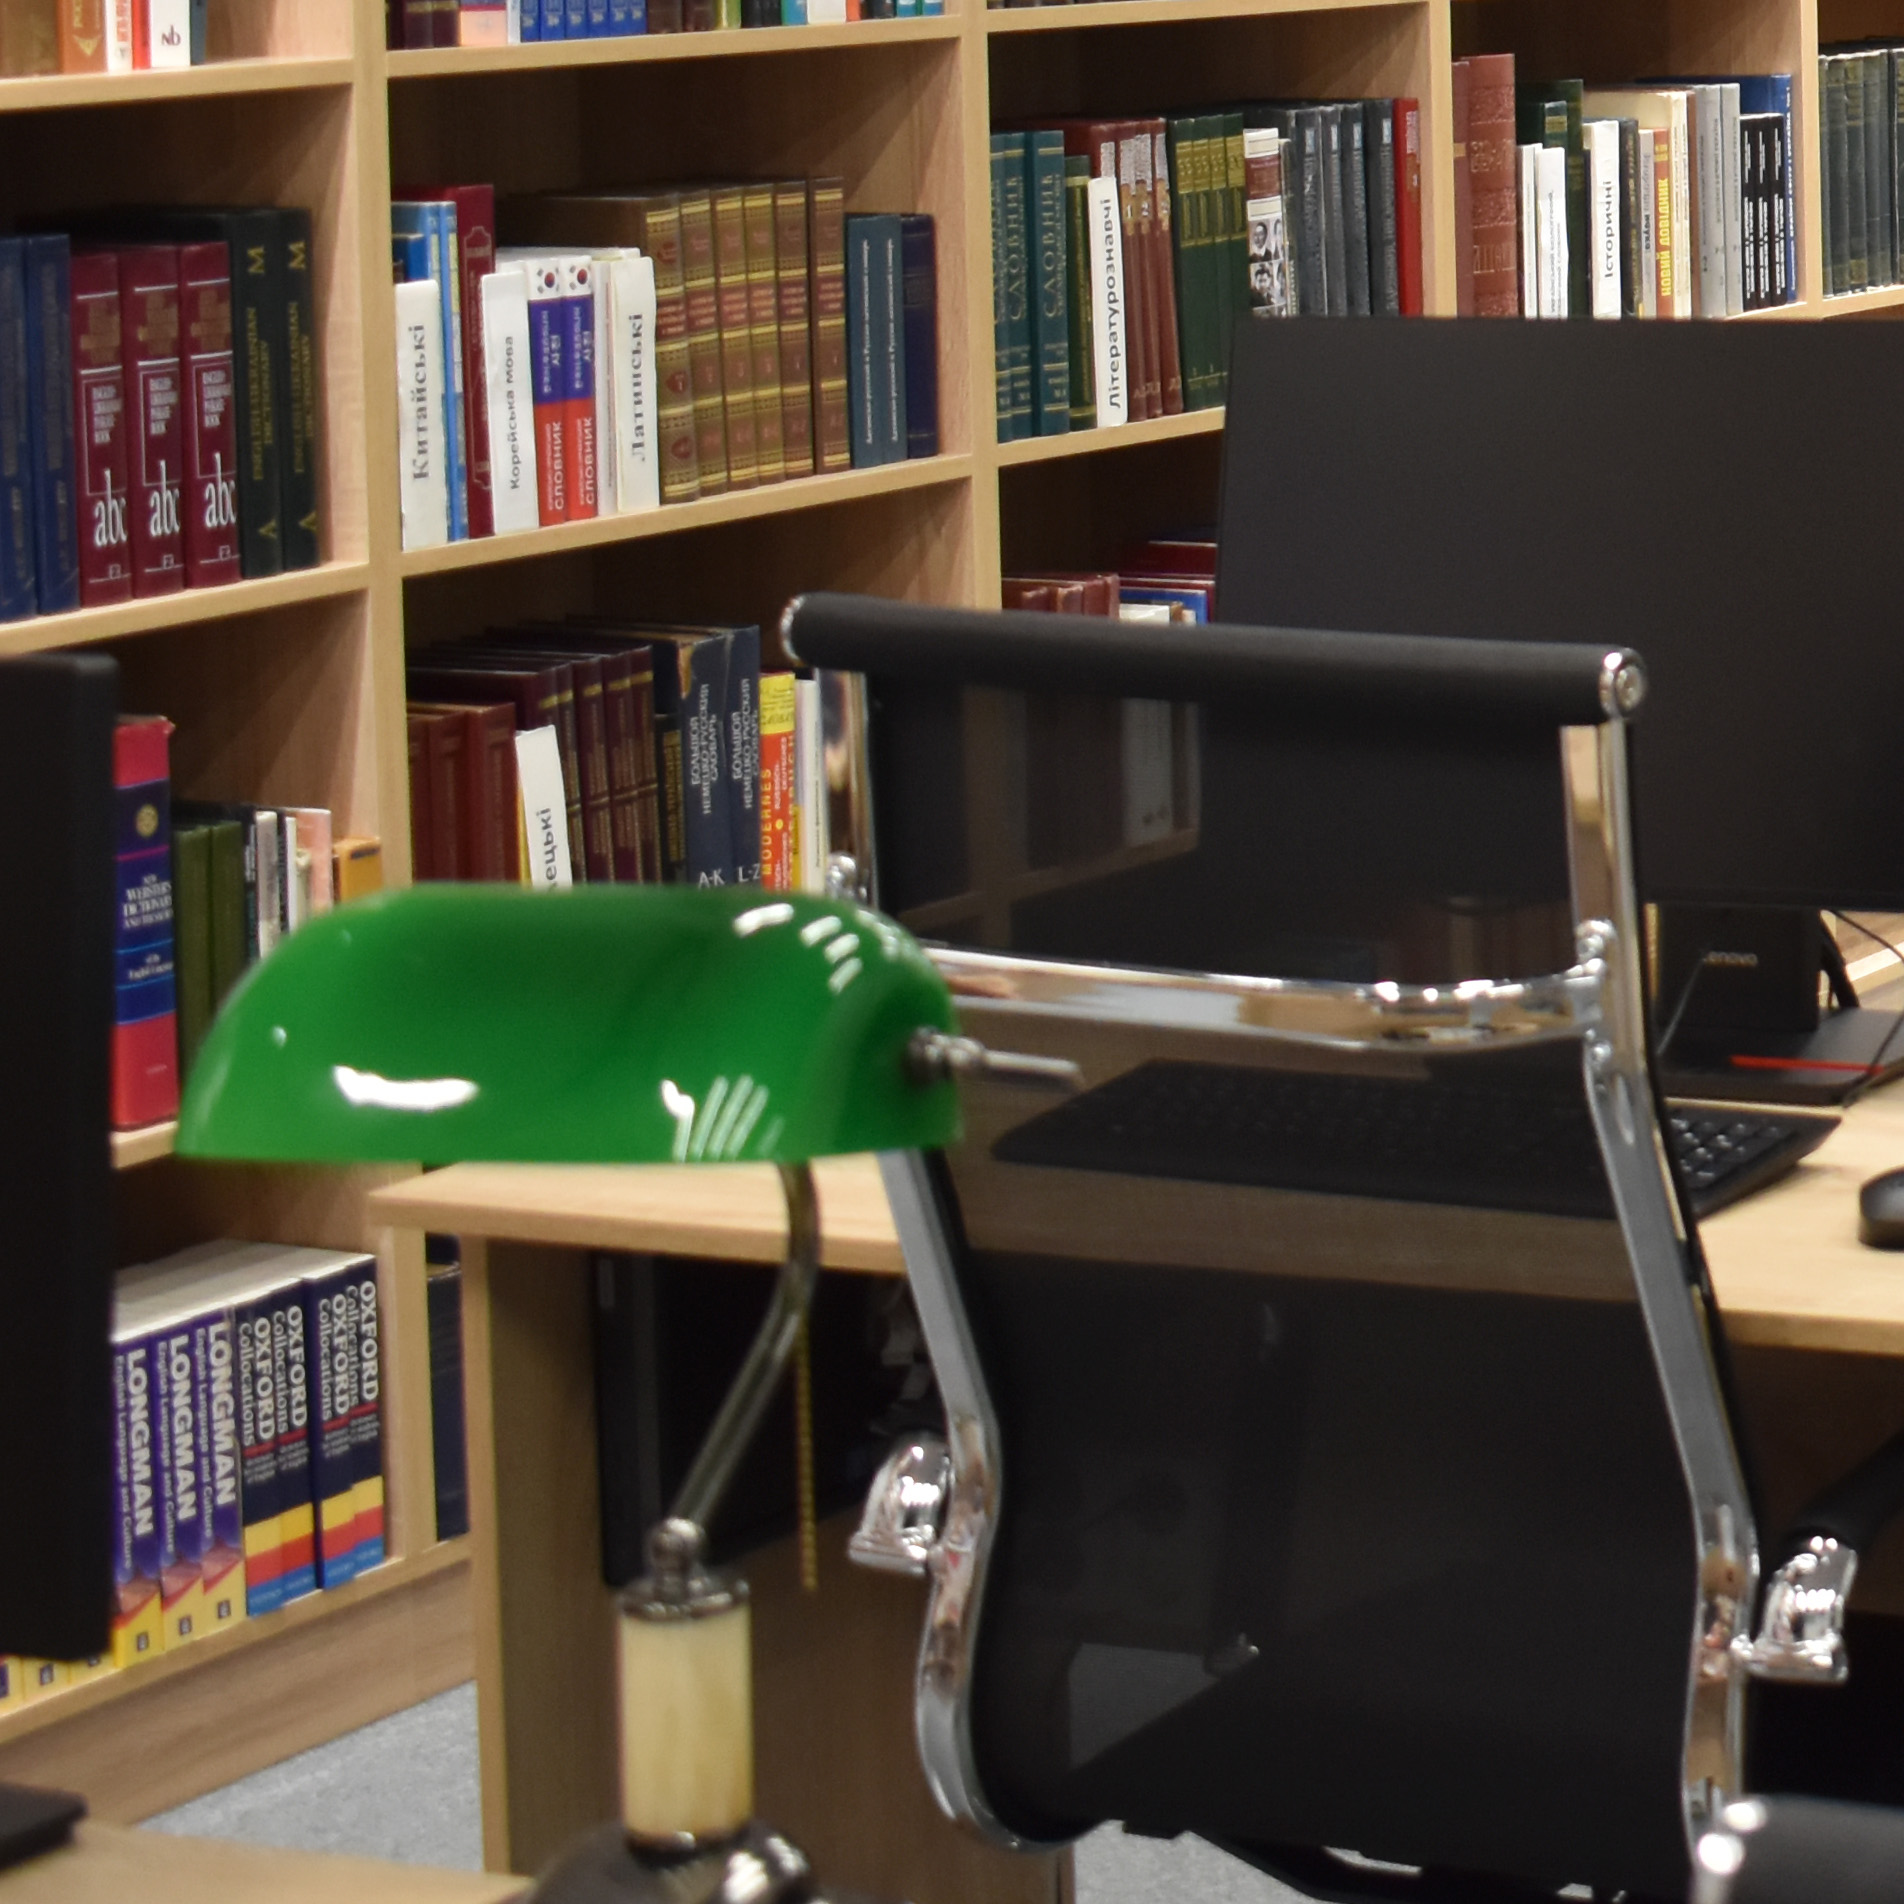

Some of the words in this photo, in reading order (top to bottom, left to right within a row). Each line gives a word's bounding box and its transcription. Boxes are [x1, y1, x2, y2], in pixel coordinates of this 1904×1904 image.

[1006, 176, 1022, 320] СЛОВНИК
[1041, 173, 1057, 317] СЛОВНИК
[1602, 180, 1615, 278] Історичні
[1657, 177, 1670, 247] ДОВІДНИК
[1099, 198, 1122, 409] Літературознавчі
[1655, 250, 1672, 297] НОВИЙ
[407, 324, 430, 480] Китайські
[503, 336, 515, 384] мова
[628, 313, 646, 462] Латинські
[504, 389, 522, 490] Корейська
[551, 420, 565, 510] СЛОВНИК
[583, 416, 596, 505] СЛОВНИК
[94, 467, 128, 547] abc
[149, 459, 180, 537] abc
[204, 451, 237, 527] abc
[690, 716, 701, 785] БОЛЬШОЙ
[699, 683, 712, 814] НЕМЕЦКО-РУССКИЙ
[708, 714, 718, 782] СЛОВАРЬ
[731, 710, 743, 779] БОЛЬШОЙ
[741, 677, 753, 809] НЕМЕЦКО-РУССКИЙ
[536, 807, 558, 887] ецькі
[760, 768, 772, 875] MODERNES
[697, 867, 726, 888] A-K
[737, 862, 760, 883] L-Z
[156, 1340, 171, 1402] English
[193, 1327, 209, 1388] English
[238, 1322, 256, 1447] Collocations
[253, 1317, 275, 1440] OXFORD
[273, 1310, 291, 1435] Collocations
[287, 1305, 308, 1427] OXFORD
[319, 1298, 334, 1421] Collocations
[331, 1293, 350, 1415] OXFORD
[345, 1284, 359, 1409] Collocations
[360, 1280, 380, 1401] OXFORD
[115, 1355, 129, 1416] English
[169, 1334, 197, 1522] LONGMAN
[196, 1390, 211, 1453] Language
[208, 1320, 237, 1507] LONGMAN
[116, 1419, 131, 1482] Language
[126, 1348, 155, 1537] LONGMAN
[158, 1404, 173, 1466] Language
[121, 1514, 134, 1570] Culture
[164, 1499, 177, 1553] Culture
[203, 1485, 215, 1539] Culture
